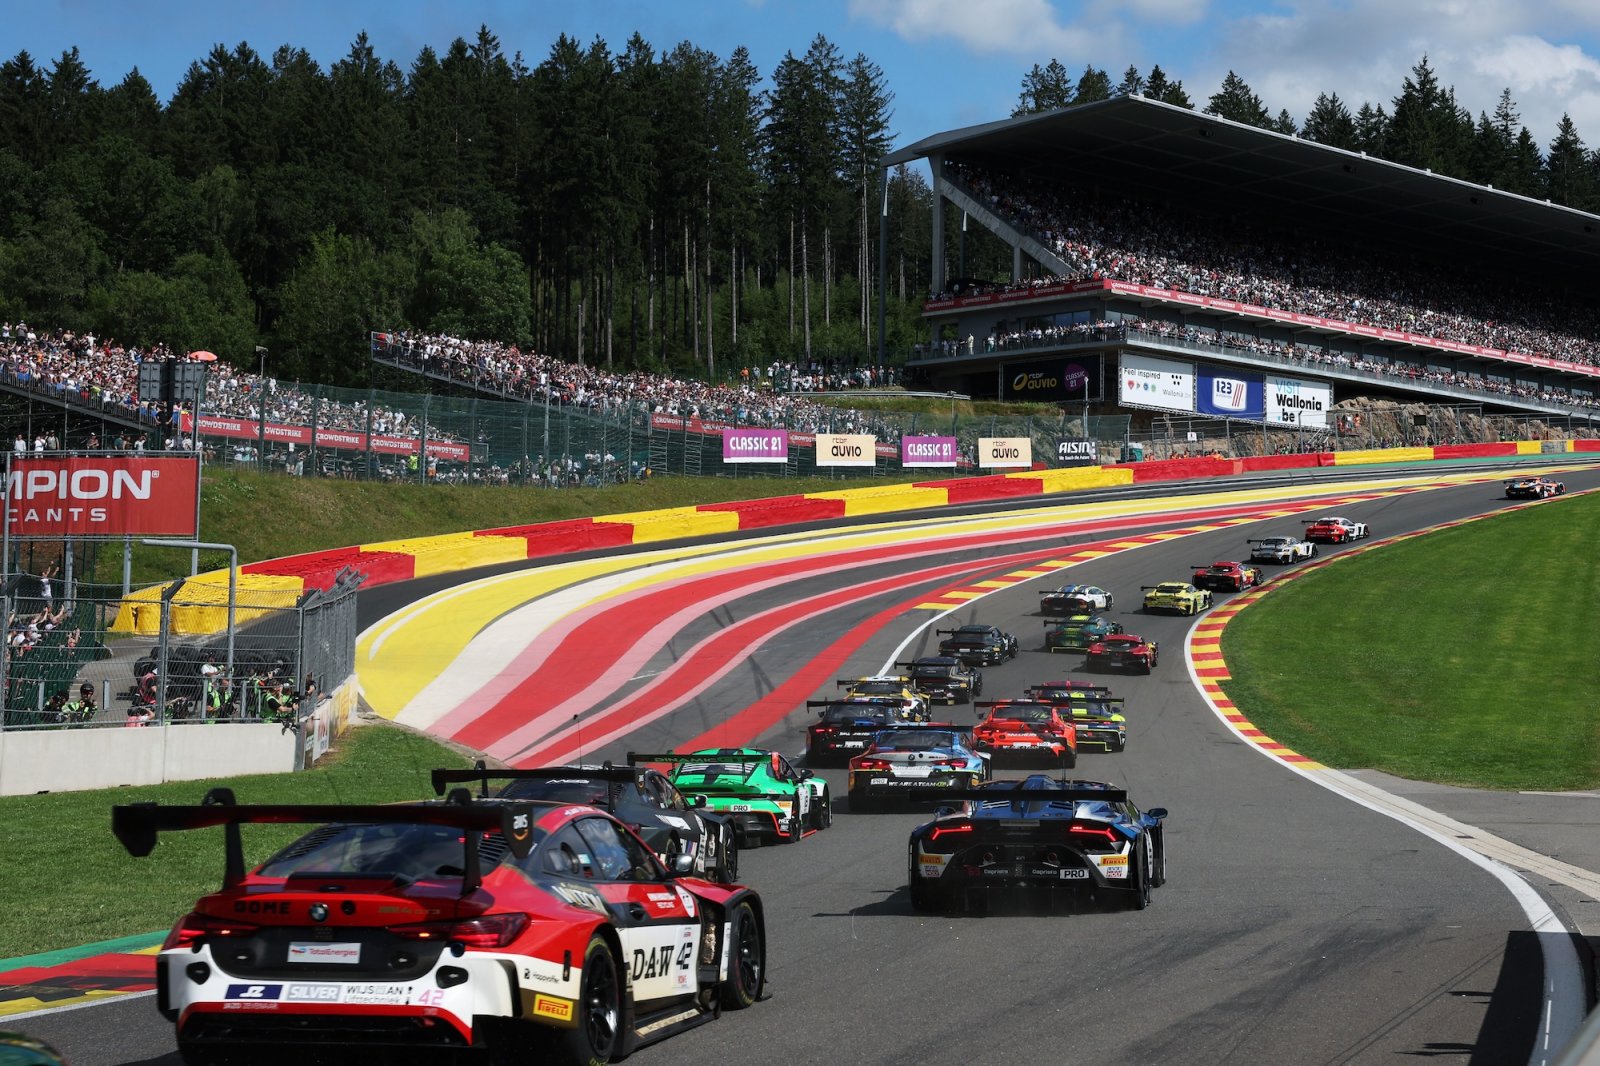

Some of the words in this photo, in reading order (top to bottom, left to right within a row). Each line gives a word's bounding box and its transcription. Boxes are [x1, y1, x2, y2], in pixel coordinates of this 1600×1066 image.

[1065, 370, 1085, 381] CLASSIC
[1027, 378, 1057, 390] auvio
[1069, 379, 1077, 388] 21
[1216, 380, 1232, 395] 123
[1276, 379, 1301, 395] VISIT
[1276, 393, 1322, 411] Wallonia
[255, 425, 302, 438] COWDSTRIKE
[315, 432, 360, 444] CROWDSTRIKE
[371, 438, 413, 450] CROWDSTRIKE
[425, 444, 465, 456] CROWDSTRIKE
[729, 437, 769, 450] CLASSIC
[770, 437, 782, 450] 21
[1058, 442, 1090, 454] AISIN
[831, 445, 862, 457] auvio
[907, 444, 941, 457] CLASSIC
[942, 444, 952, 457] 21
[991, 447, 1020, 459] auvio
[513, 814, 528, 830] aws
[1064, 869, 1085, 878] PRO
[676, 942, 692, 970] 42
[289, 986, 338, 999] SILVER
[418, 989, 444, 1005] 42
[538, 999, 569, 1016] PIRELLI
